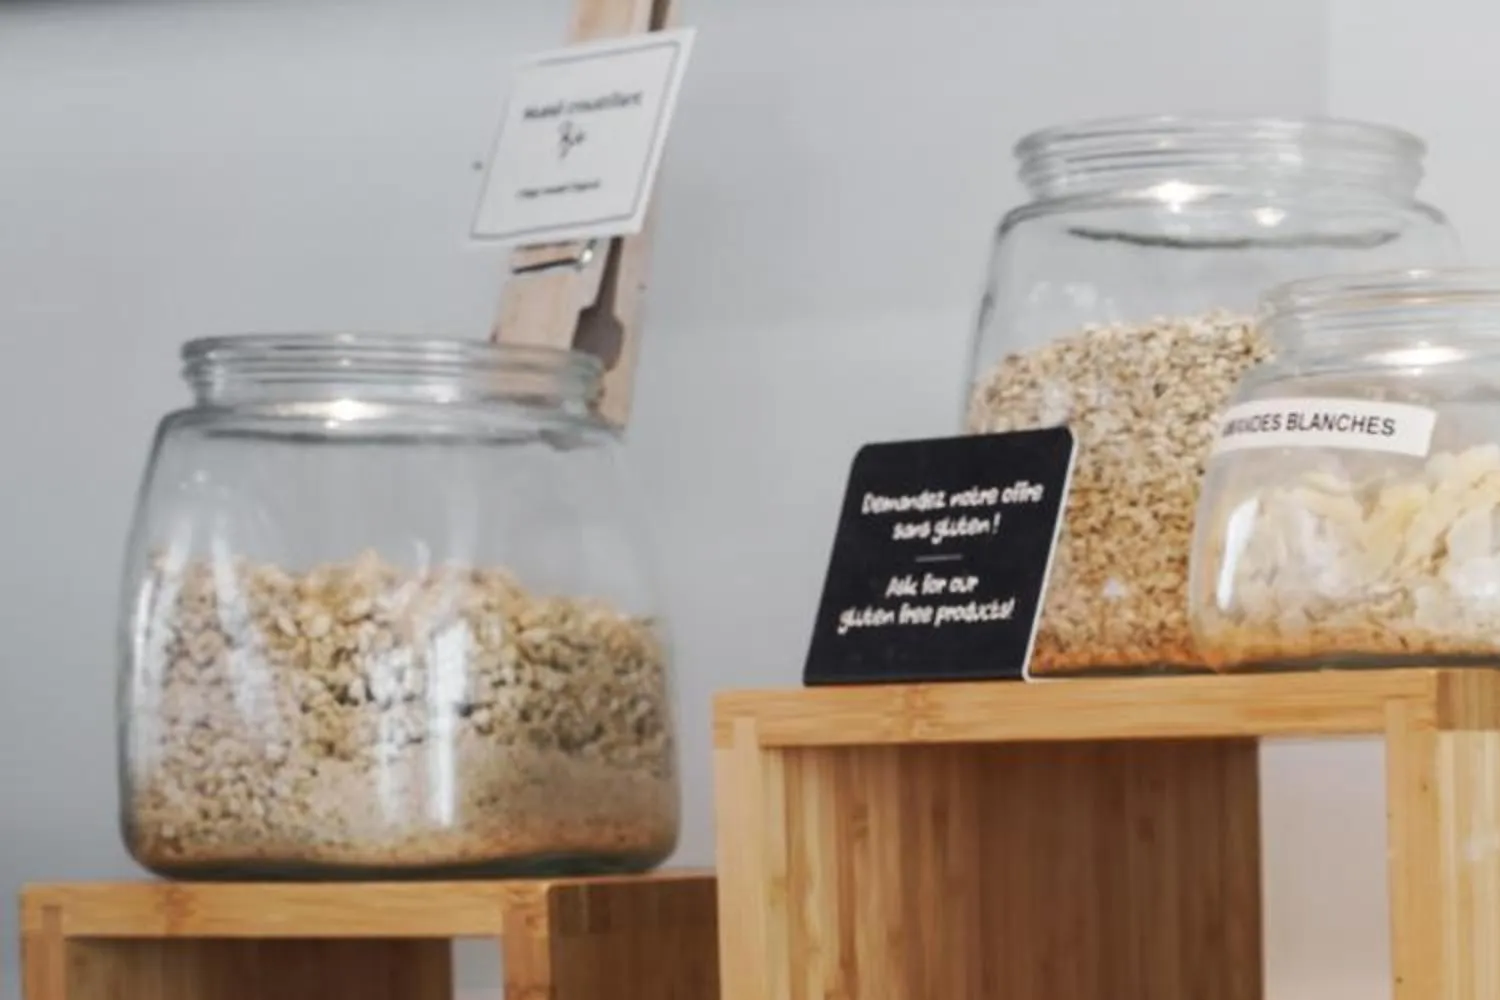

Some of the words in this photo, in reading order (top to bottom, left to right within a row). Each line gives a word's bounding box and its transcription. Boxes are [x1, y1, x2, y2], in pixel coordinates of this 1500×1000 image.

[1286, 411, 1397, 437] BLANCHES
[861, 489, 947, 515] Demandez
[950, 485, 999, 507] notre
[1001, 480, 1044, 504] offre
[892, 520, 931, 541] sans
[931, 515, 990, 545] gluten
[885, 574, 918, 598] Ask
[921, 572, 947, 596] for
[949, 575, 980, 594] our
[837, 604, 895, 635] gluten
[898, 602, 934, 625] free
[934, 597, 1016, 628] products!
